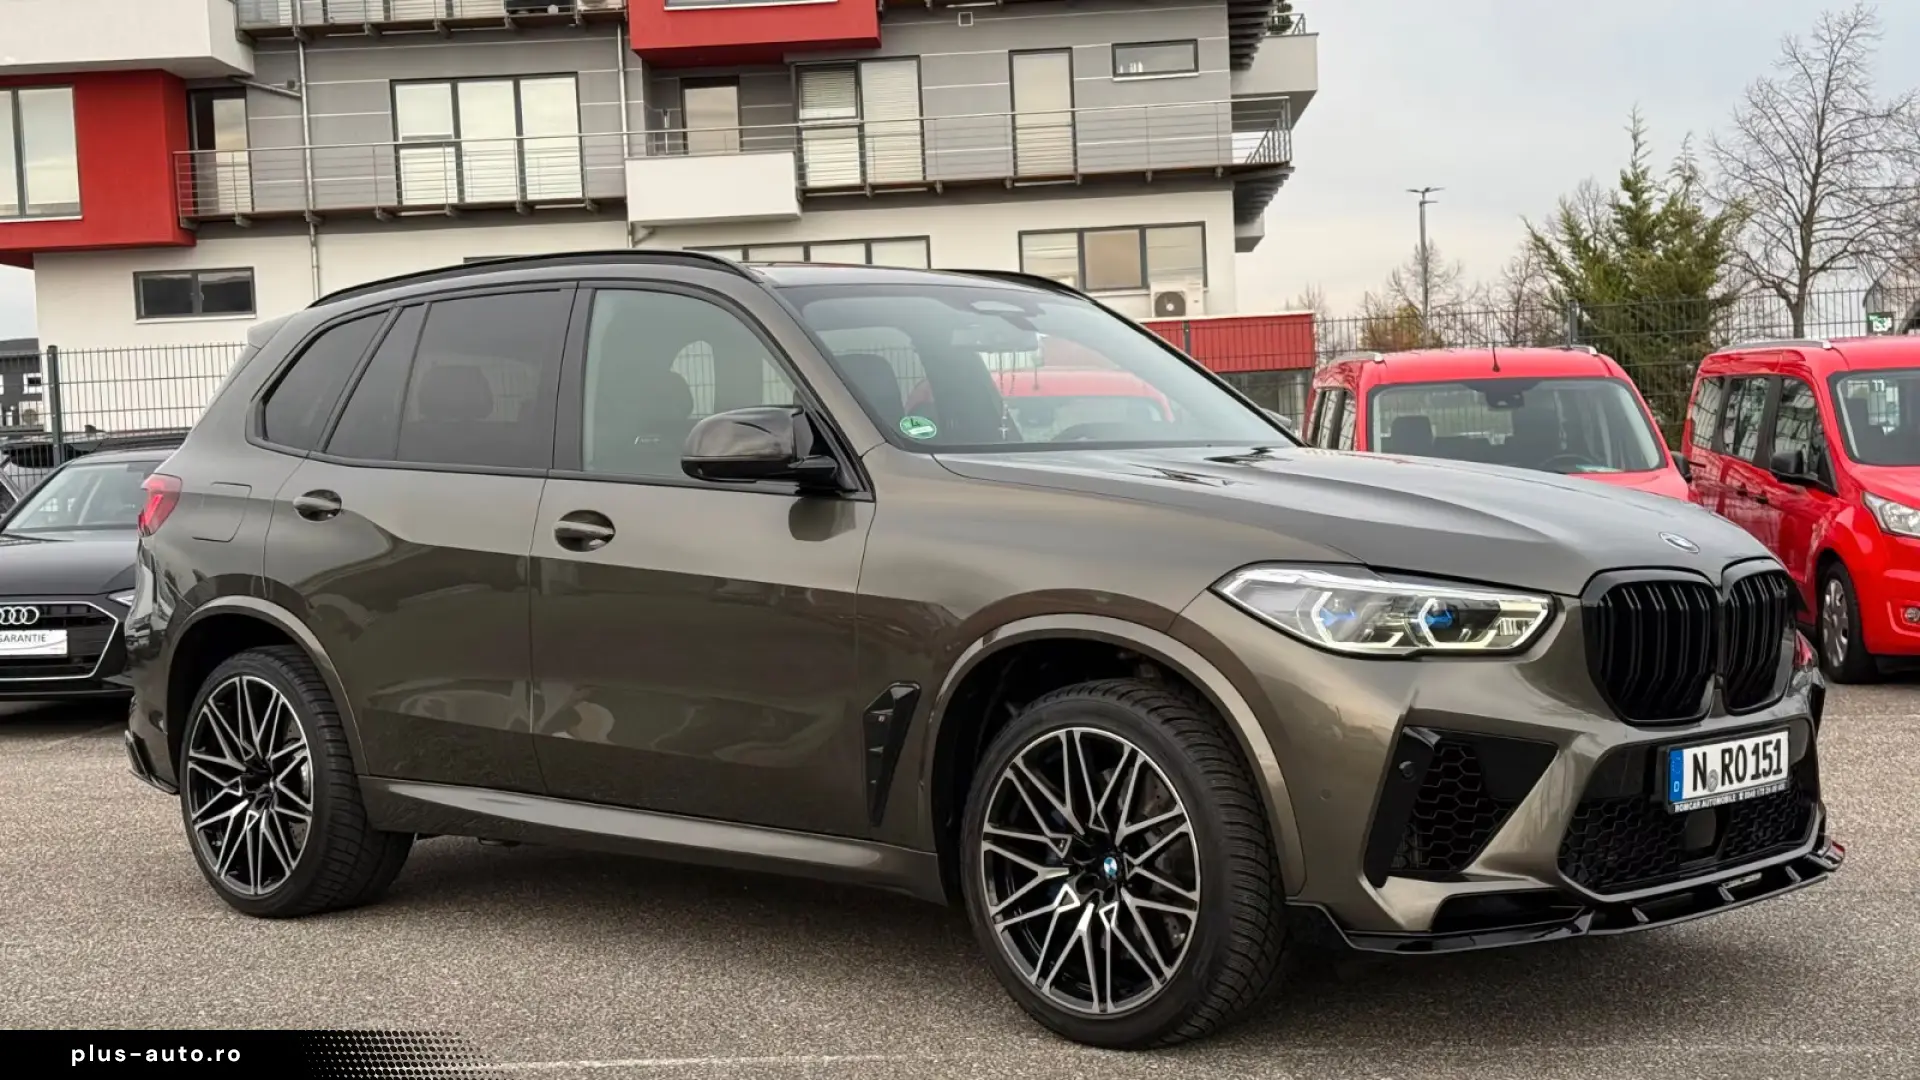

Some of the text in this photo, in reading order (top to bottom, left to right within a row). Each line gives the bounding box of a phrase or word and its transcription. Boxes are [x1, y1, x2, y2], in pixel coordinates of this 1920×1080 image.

[1692, 751, 1707, 792] N
[1721, 744, 1748, 787] RO
[1751, 738, 1783, 780] 151
